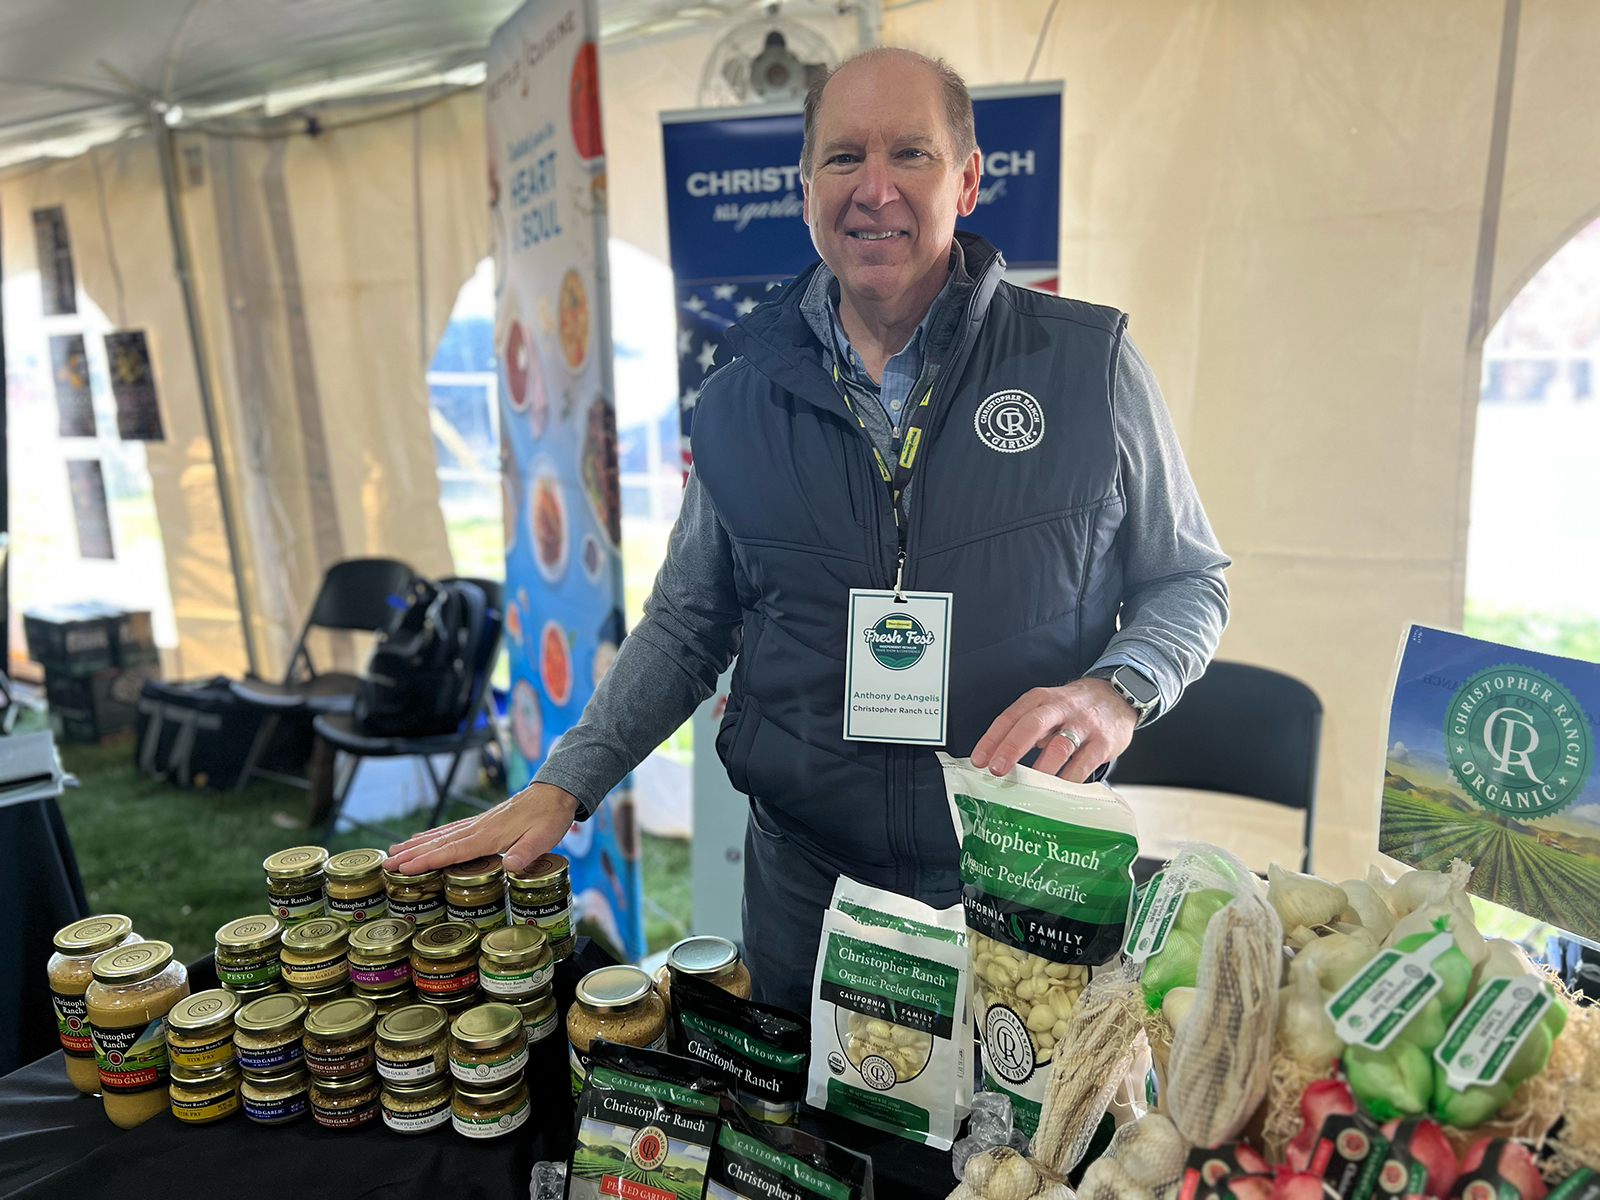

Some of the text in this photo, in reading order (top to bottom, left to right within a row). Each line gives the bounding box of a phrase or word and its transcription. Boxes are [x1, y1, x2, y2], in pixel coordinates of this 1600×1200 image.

[510, 152, 556, 209] HEART
[686, 165, 800, 197] CHRIST
[521, 200, 562, 248] SOUL
[980, 395, 1021, 424] CHRISTOPHER
[1023, 399, 1040, 423] RANCH
[991, 435, 1034, 449] GARLIC
[864, 629, 934, 645] Fresh Fest
[853, 691, 939, 703] Anthony DeAngelis
[1454, 676, 1553, 735] CHRISTOPHER
[853, 705, 897, 713] Christopher
[899, 707, 922, 715] Ranch
[1554, 703, 1580, 768] RANCH
[1461, 761, 1557, 808] ORGANIC
[1046, 841, 1100, 871] Ranch
[961, 851, 1087, 904] Organic Peeled Garlic
[290, 896, 312, 904] Ranch
[332, 901, 366, 910] Christopher
[418, 901, 438, 911] Ranch
[477, 905, 498, 916] Ranch
[539, 905, 560, 915] Ranch
[961, 895, 1005, 923] LIFORNIA
[969, 911, 1005, 933] GROWN
[1030, 922, 1083, 945] FAMILY
[1029, 935, 1083, 955] OWNED
[316, 961, 333, 970] Ranch
[839, 947, 946, 988] Christopher Ranch
[315, 971, 335, 980] GARLIC
[838, 968, 940, 1006] Organic Peeled Garlic
[54, 996, 85, 1008] Christoph
[840, 990, 886, 1009] CALIFORNIA
[853, 1001, 885, 1014] GROWN
[62, 1006, 84, 1015] Ranch
[901, 1008, 932, 1022] FAMILY
[900, 1015, 932, 1028] OWNED
[93, 1030, 135, 1042] Christopher
[102, 1040, 126, 1048] Ranch
[693, 1017, 742, 1045] CALIFORNIA
[750, 1045, 782, 1063] GROWN
[1016, 1025, 1030, 1058] RANCH
[205, 1041, 223, 1050] Ranch
[262, 1055, 285, 1063] GARLIC
[688, 1040, 743, 1078] Christopher
[744, 1068, 780, 1093] Ranch
[991, 1052, 1011, 1076] SINCE
[124, 1074, 154, 1084] GARLIC
[1013, 1065, 1027, 1079] 1956
[611, 1077, 705, 1106] CALIFORNIA GROWN
[415, 1117, 436, 1125] GARLIC
[603, 1097, 671, 1123] Christopher
[673, 1113, 706, 1133] Ranch
[634, 1151, 648, 1167] SINCE
[737, 1141, 832, 1191] CALIFORNIA GROWN
[606, 1180, 639, 1196] PELED
[727, 1162, 792, 1200] Christopher
